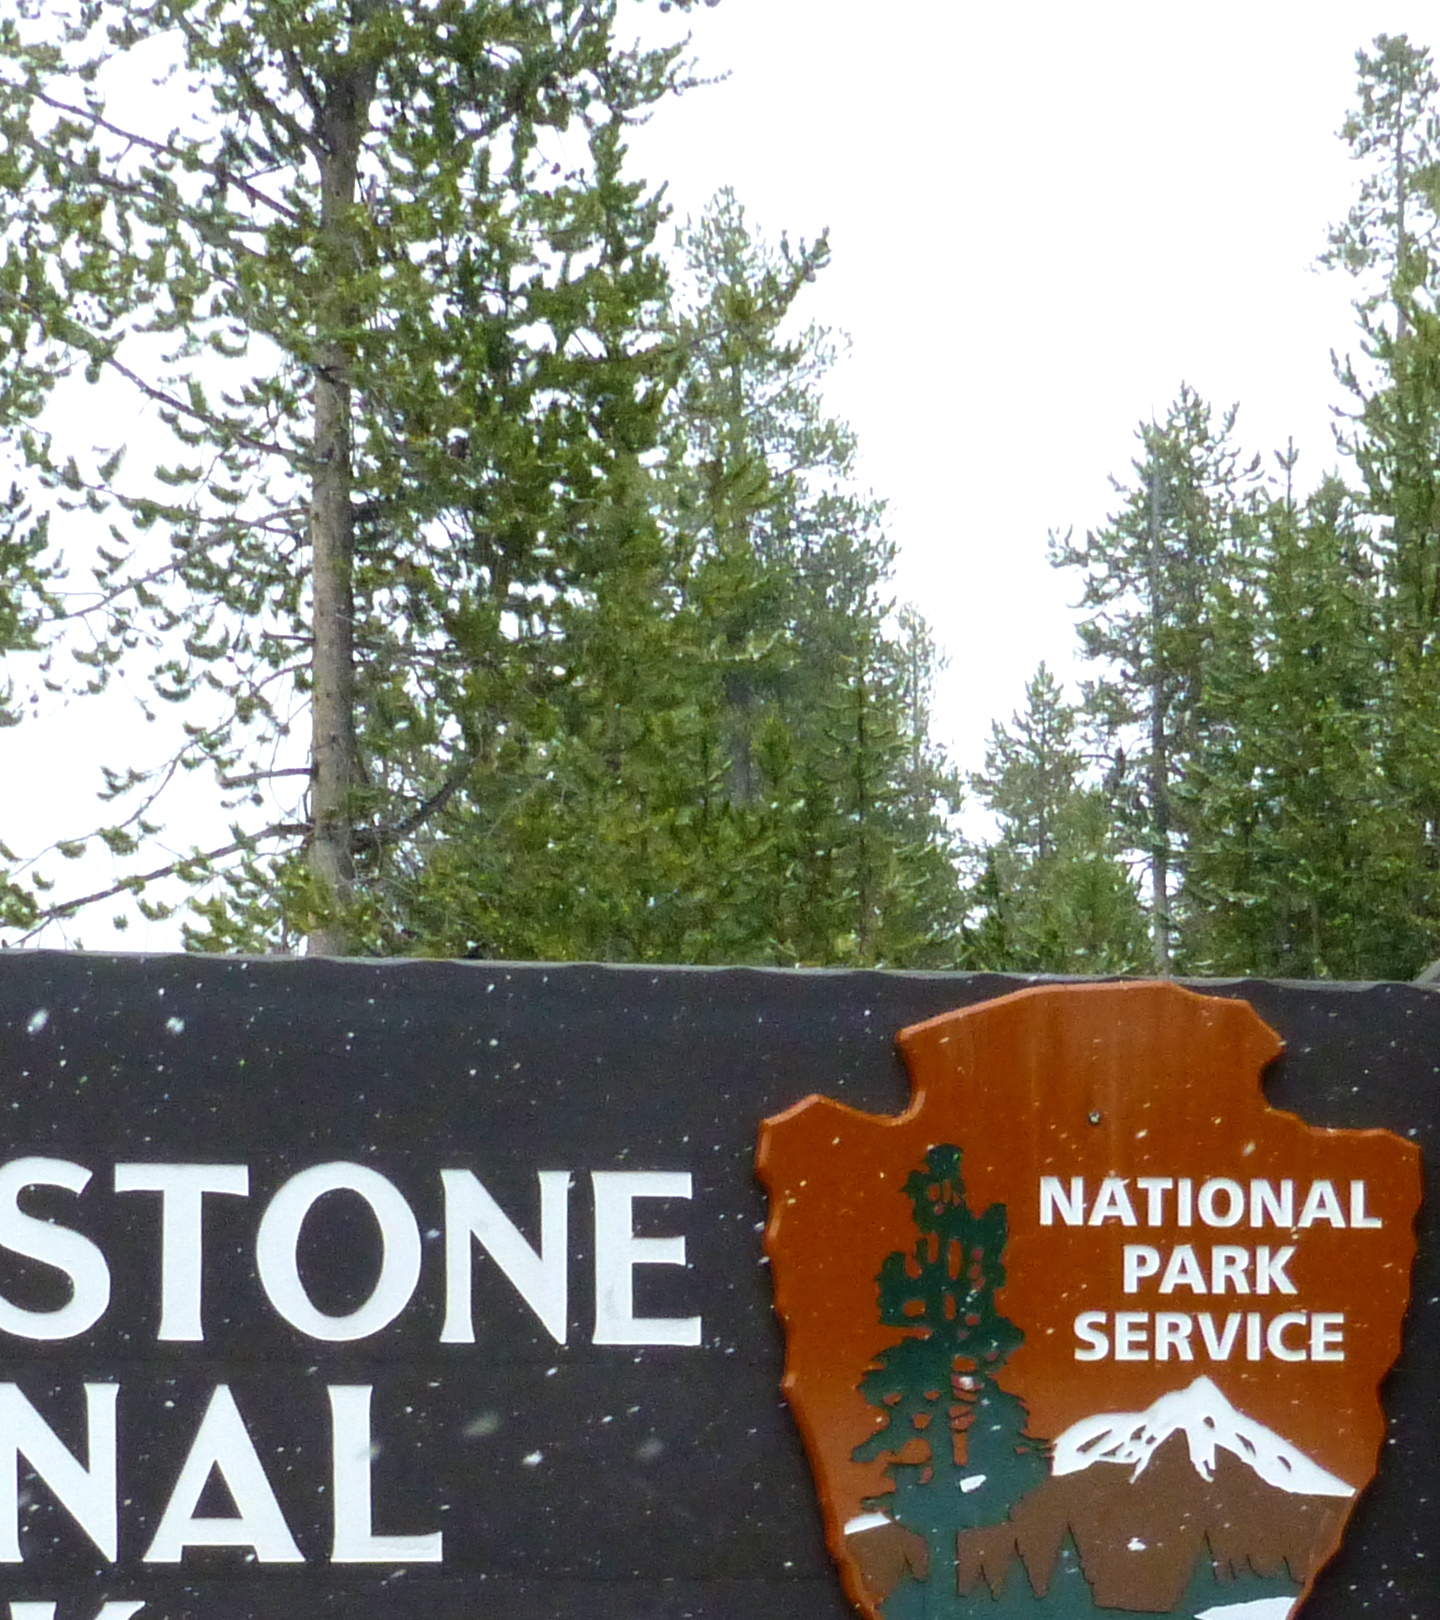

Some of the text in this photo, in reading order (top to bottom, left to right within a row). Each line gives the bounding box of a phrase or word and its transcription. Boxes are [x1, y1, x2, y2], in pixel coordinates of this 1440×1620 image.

[1038, 1175, 1383, 1229] NATIONAL
[1122, 1243, 1299, 1296] PARK
[1073, 1310, 1346, 1363] SERVICE
